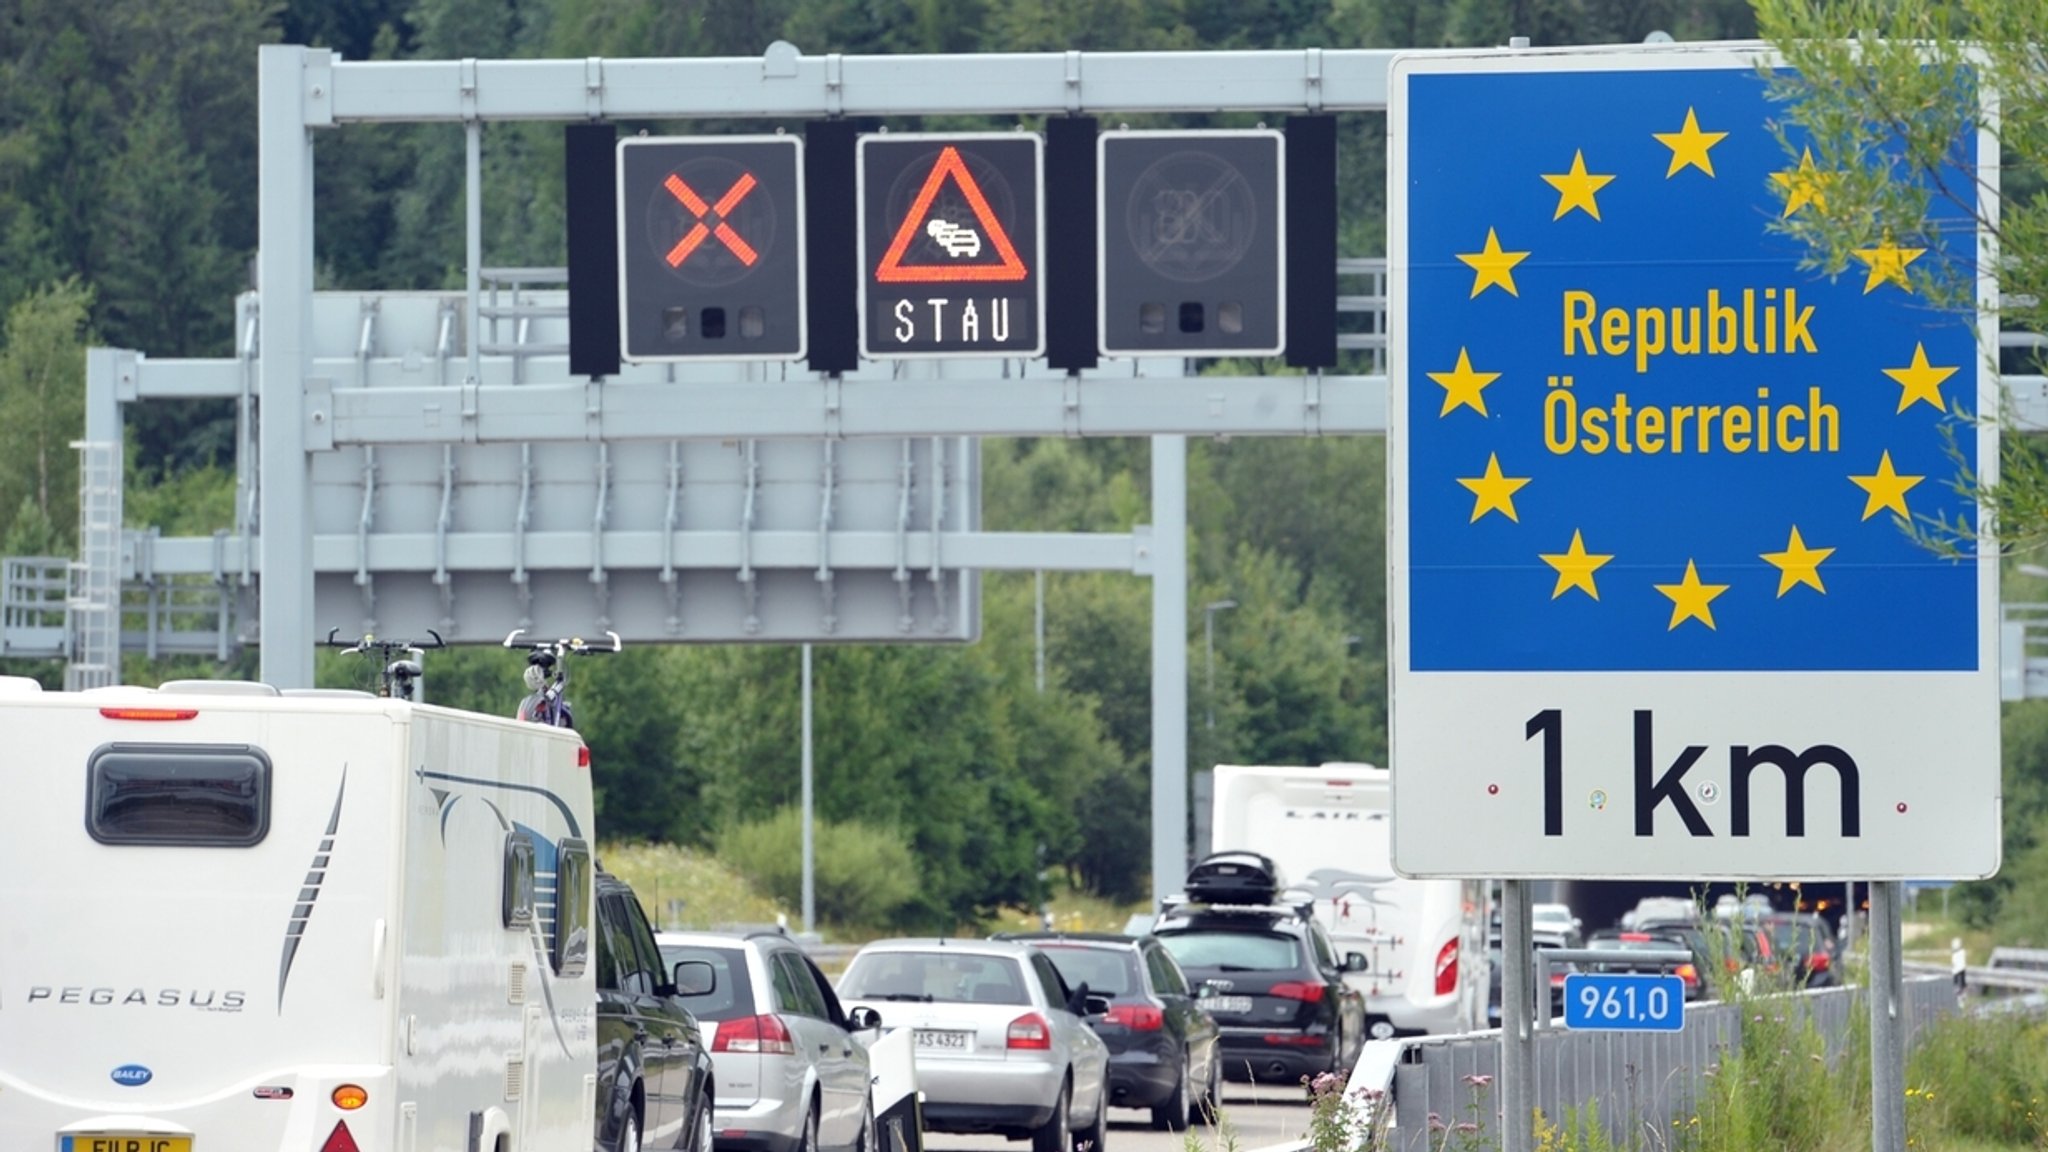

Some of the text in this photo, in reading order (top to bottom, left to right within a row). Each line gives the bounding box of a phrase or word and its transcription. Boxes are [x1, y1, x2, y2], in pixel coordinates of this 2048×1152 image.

[895, 298, 1008, 342] STAU
[1563, 288, 1818, 373] Republik
[1544, 376, 1839, 454] Österreich
[1526, 709, 1861, 837] 1 km
[1285, 811, 1383, 820] LAIKA
[28, 986, 246, 1008] PEGASUS
[1580, 986, 1669, 1022] 961,0
[937, 1034, 966, 1048] 4321
[113, 1071, 149, 1080] BAILEY
